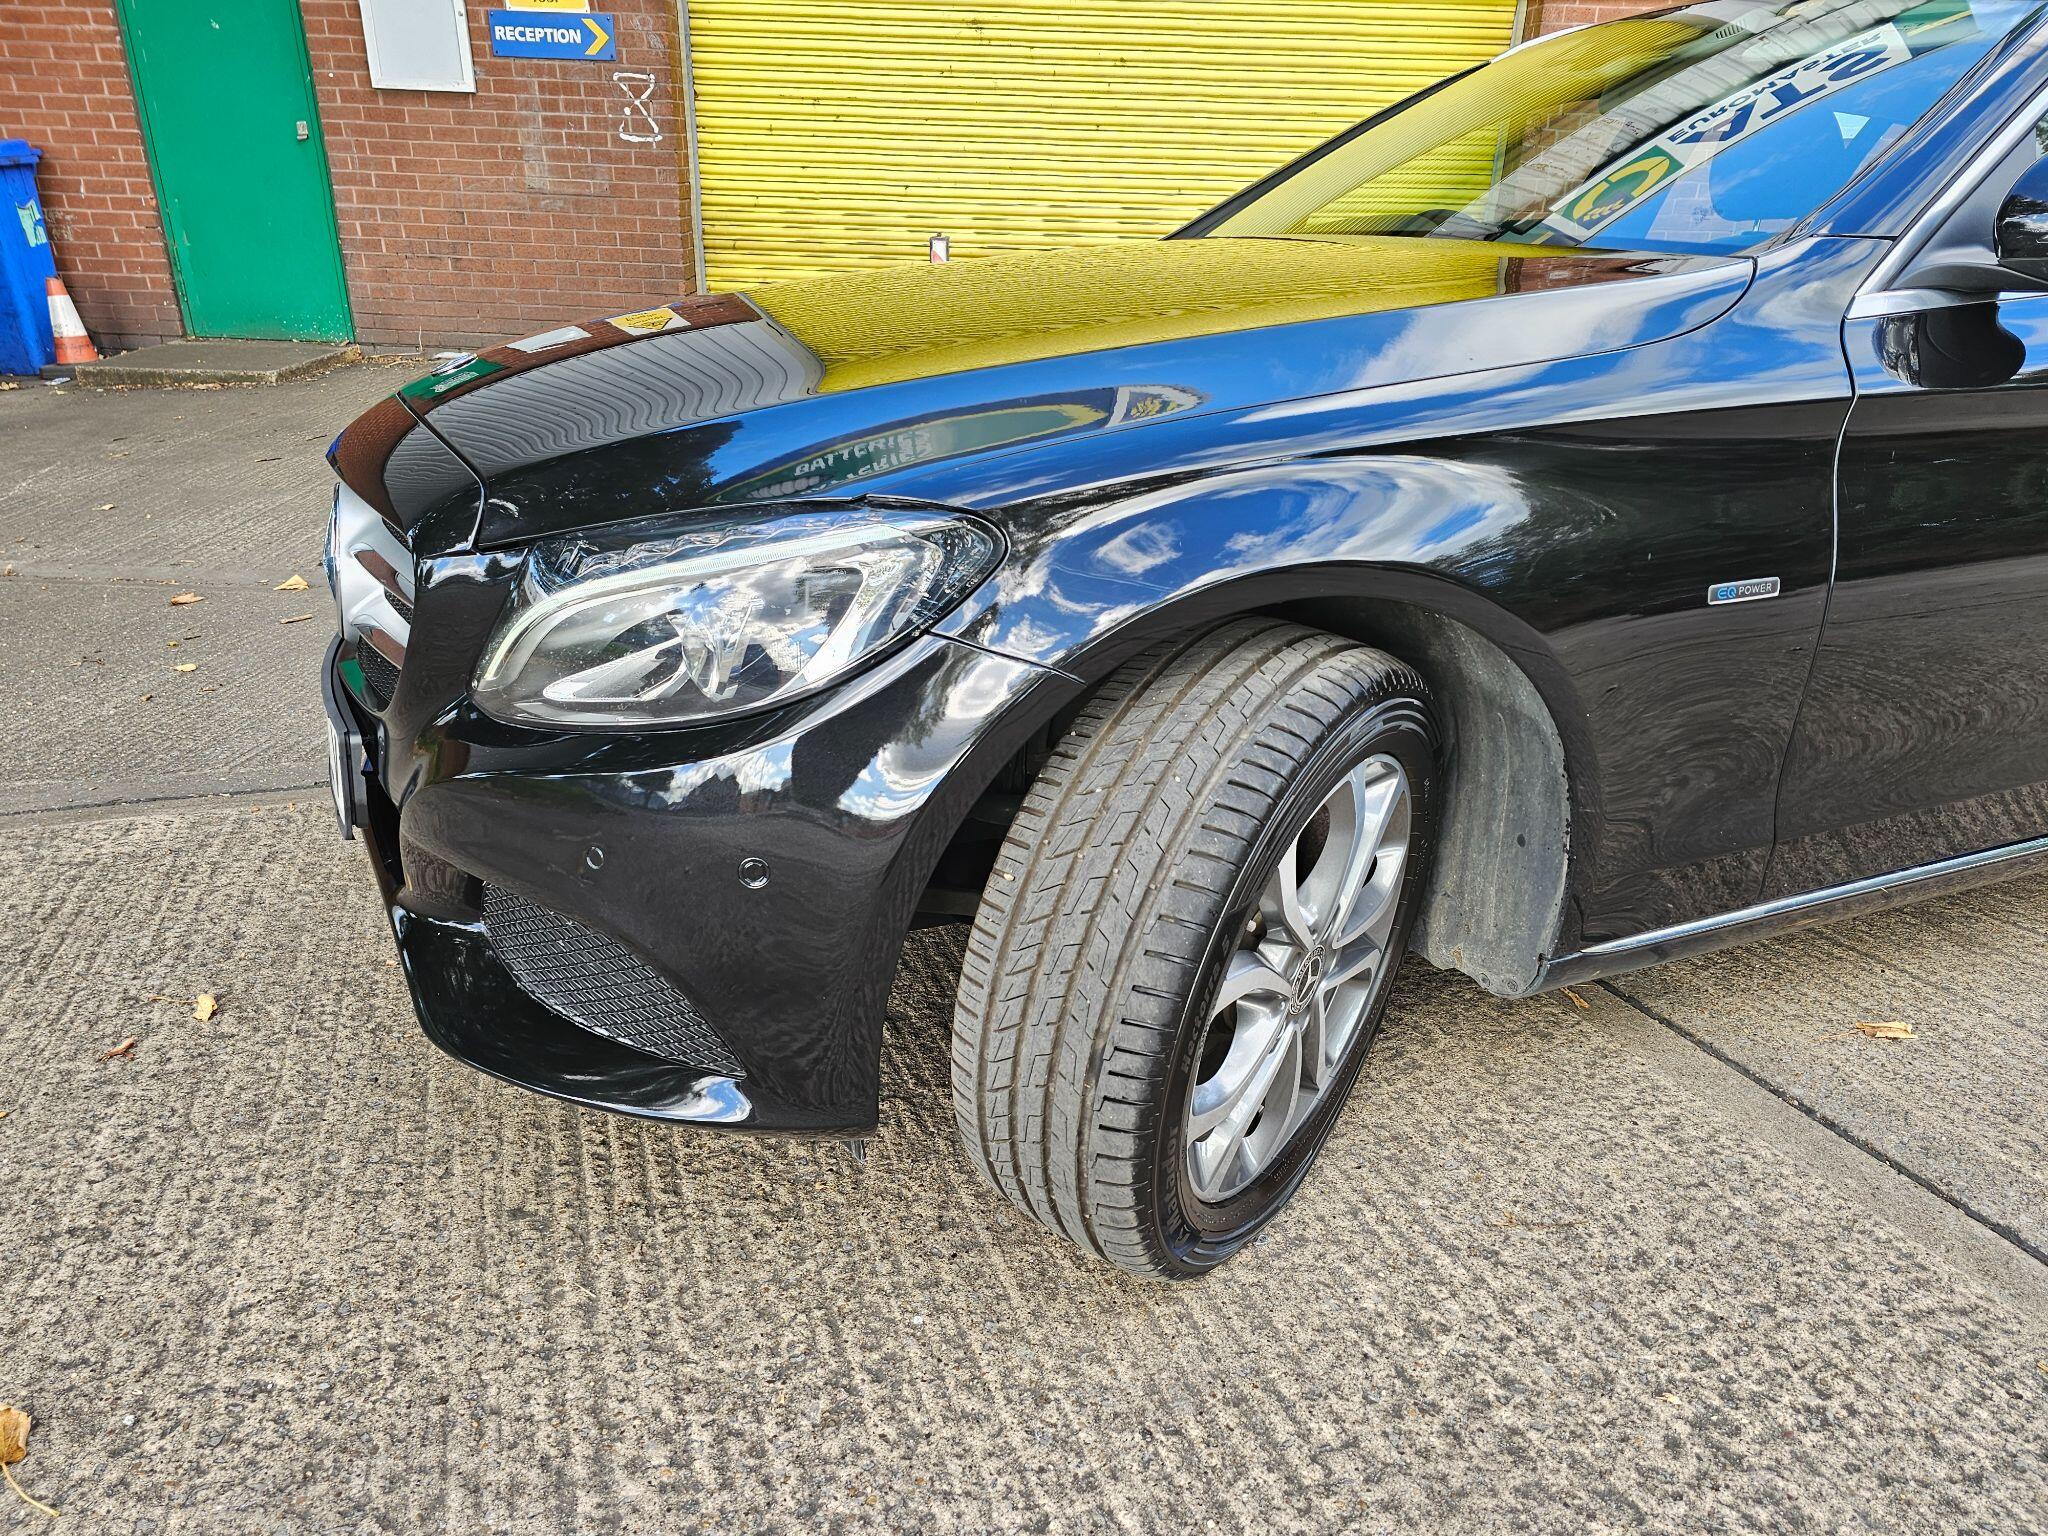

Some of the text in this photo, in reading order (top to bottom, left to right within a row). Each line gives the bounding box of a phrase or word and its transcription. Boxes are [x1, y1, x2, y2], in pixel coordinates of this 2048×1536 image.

[495, 26, 582, 43] RECEPTION
[1717, 582, 1772, 600] EQ POWER
[1166, 1126, 1182, 1234] Matador
